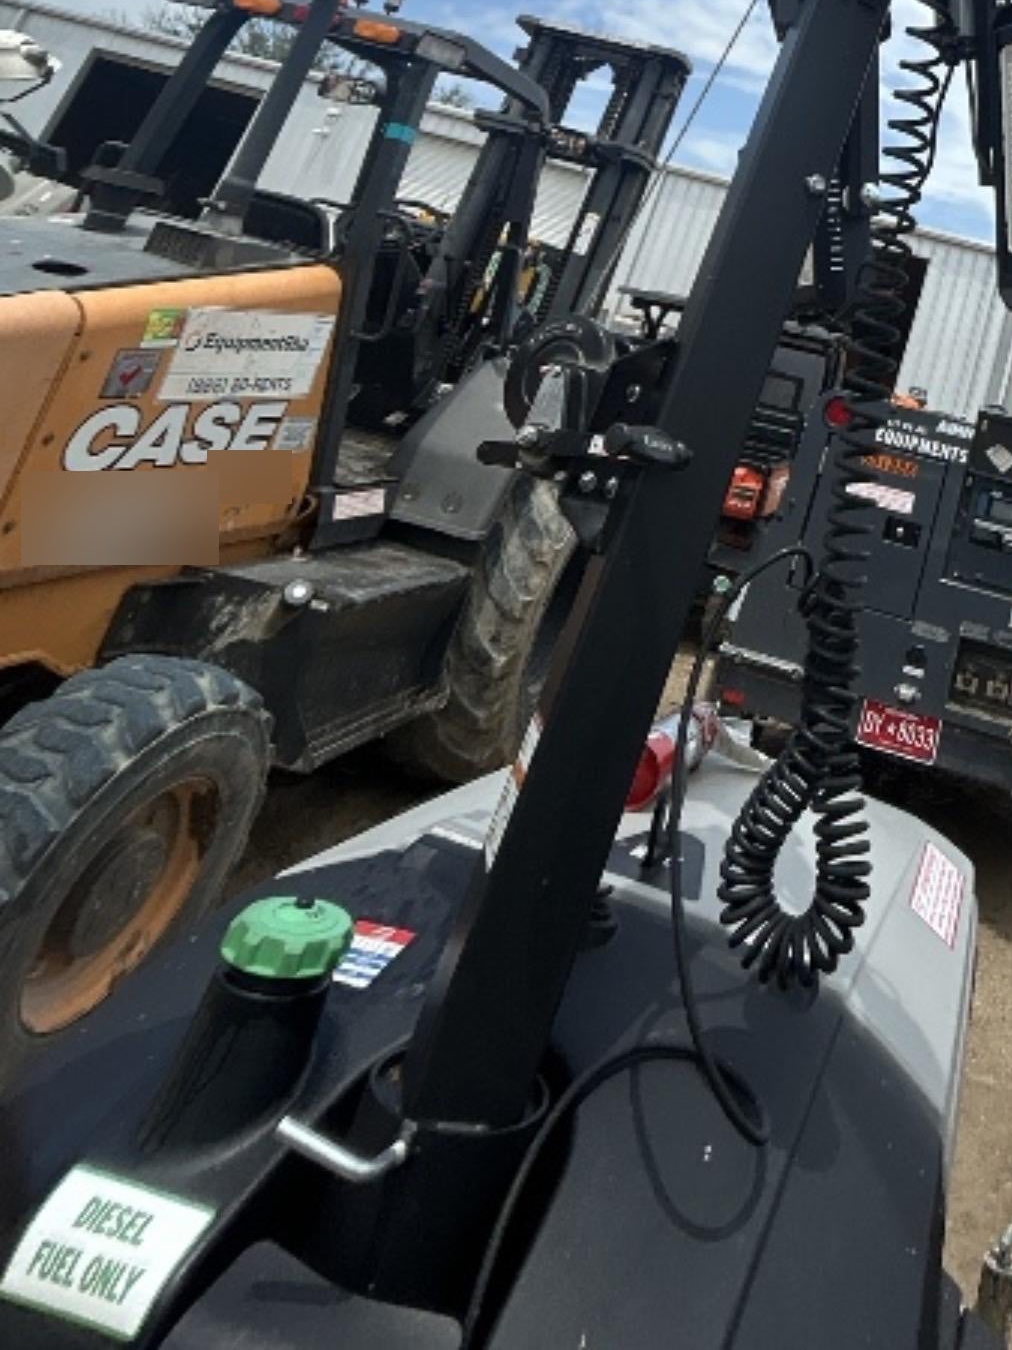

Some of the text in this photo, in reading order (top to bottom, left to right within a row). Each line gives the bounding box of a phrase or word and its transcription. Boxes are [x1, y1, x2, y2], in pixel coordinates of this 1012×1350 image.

[62, 401, 289, 471] CASE
[72, 1196, 155, 1246] DIESEL
[26, 1238, 149, 1306] FUEL ONLY
